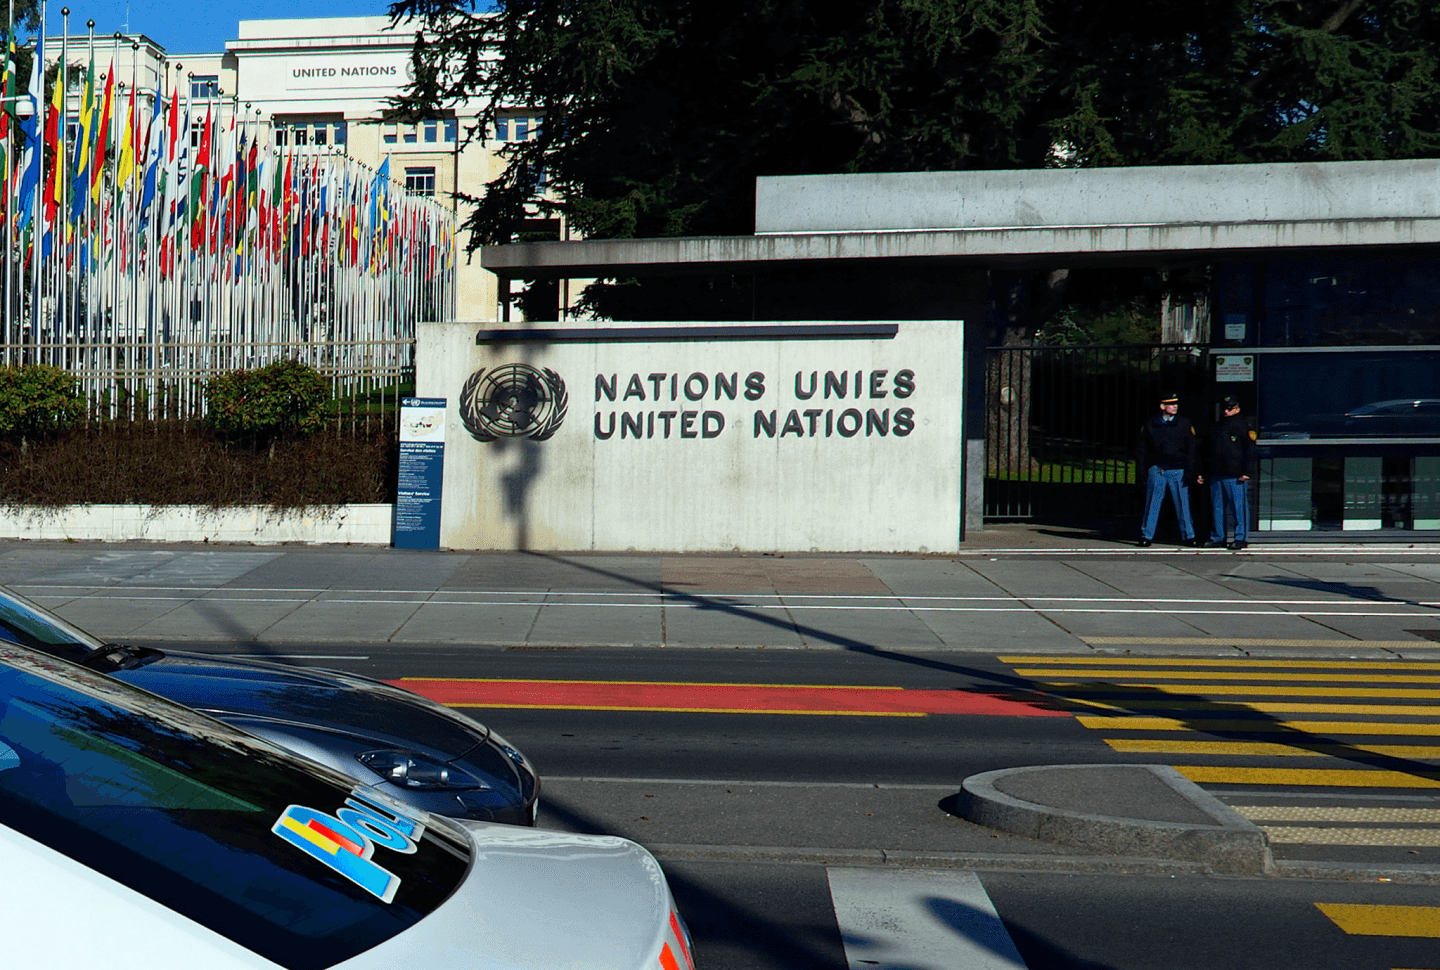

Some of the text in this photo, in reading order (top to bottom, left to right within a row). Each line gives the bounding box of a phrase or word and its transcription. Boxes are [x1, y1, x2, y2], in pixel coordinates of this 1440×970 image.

[293, 66, 397, 78] UNITED NATIONS
[595, 369, 916, 402] NATIONS UNIES
[594, 407, 916, 440] UNITED NATIONS
